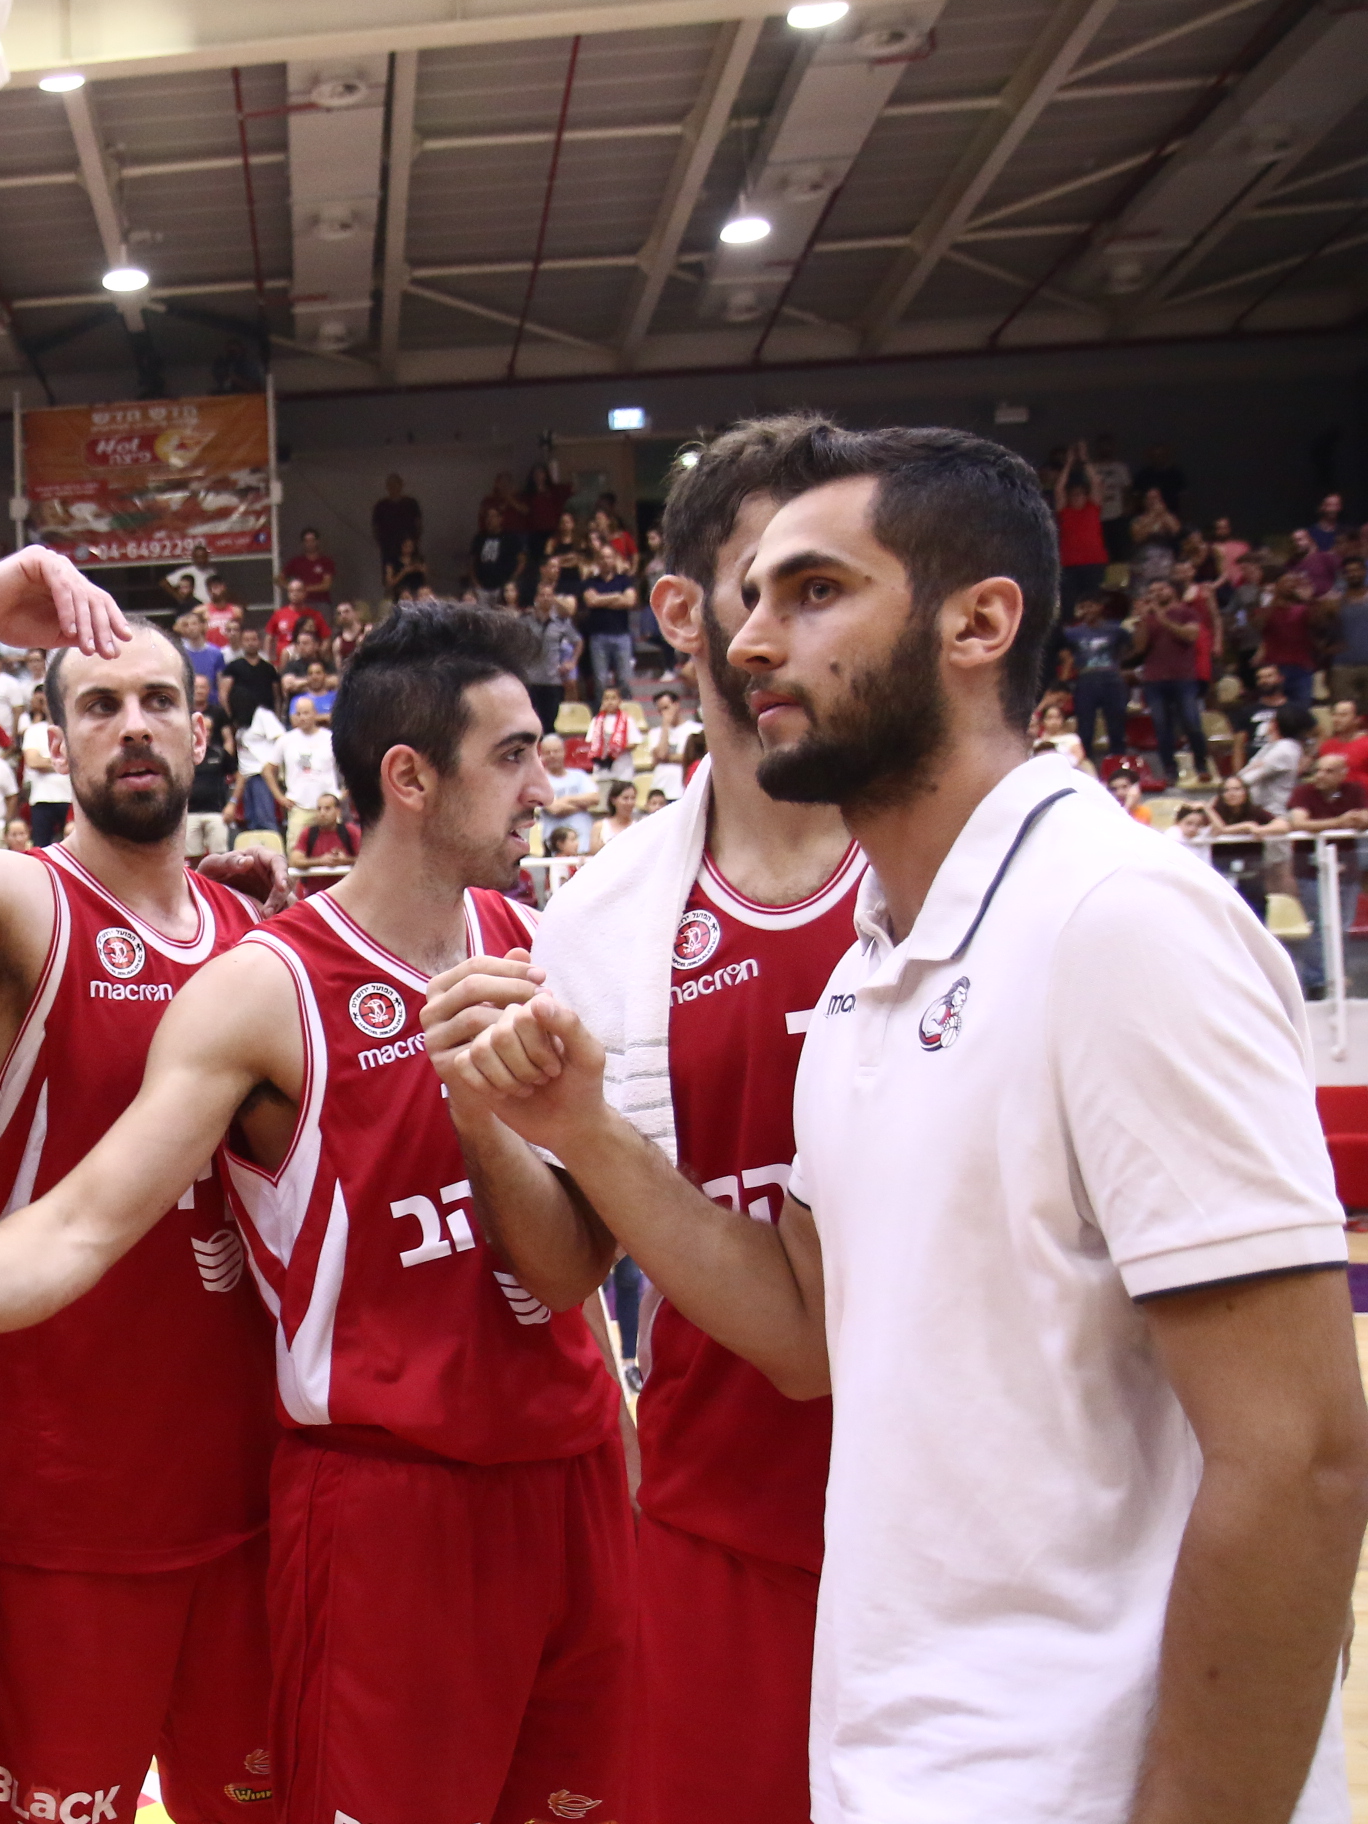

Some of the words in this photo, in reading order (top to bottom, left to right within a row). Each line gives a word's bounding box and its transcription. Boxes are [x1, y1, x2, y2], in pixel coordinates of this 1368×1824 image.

[90, 980, 173, 1002] macron
[351, 986, 369, 1009] ירושלים
[371, 984, 394, 997] הפועל
[357, 1032, 426, 1071] macro
